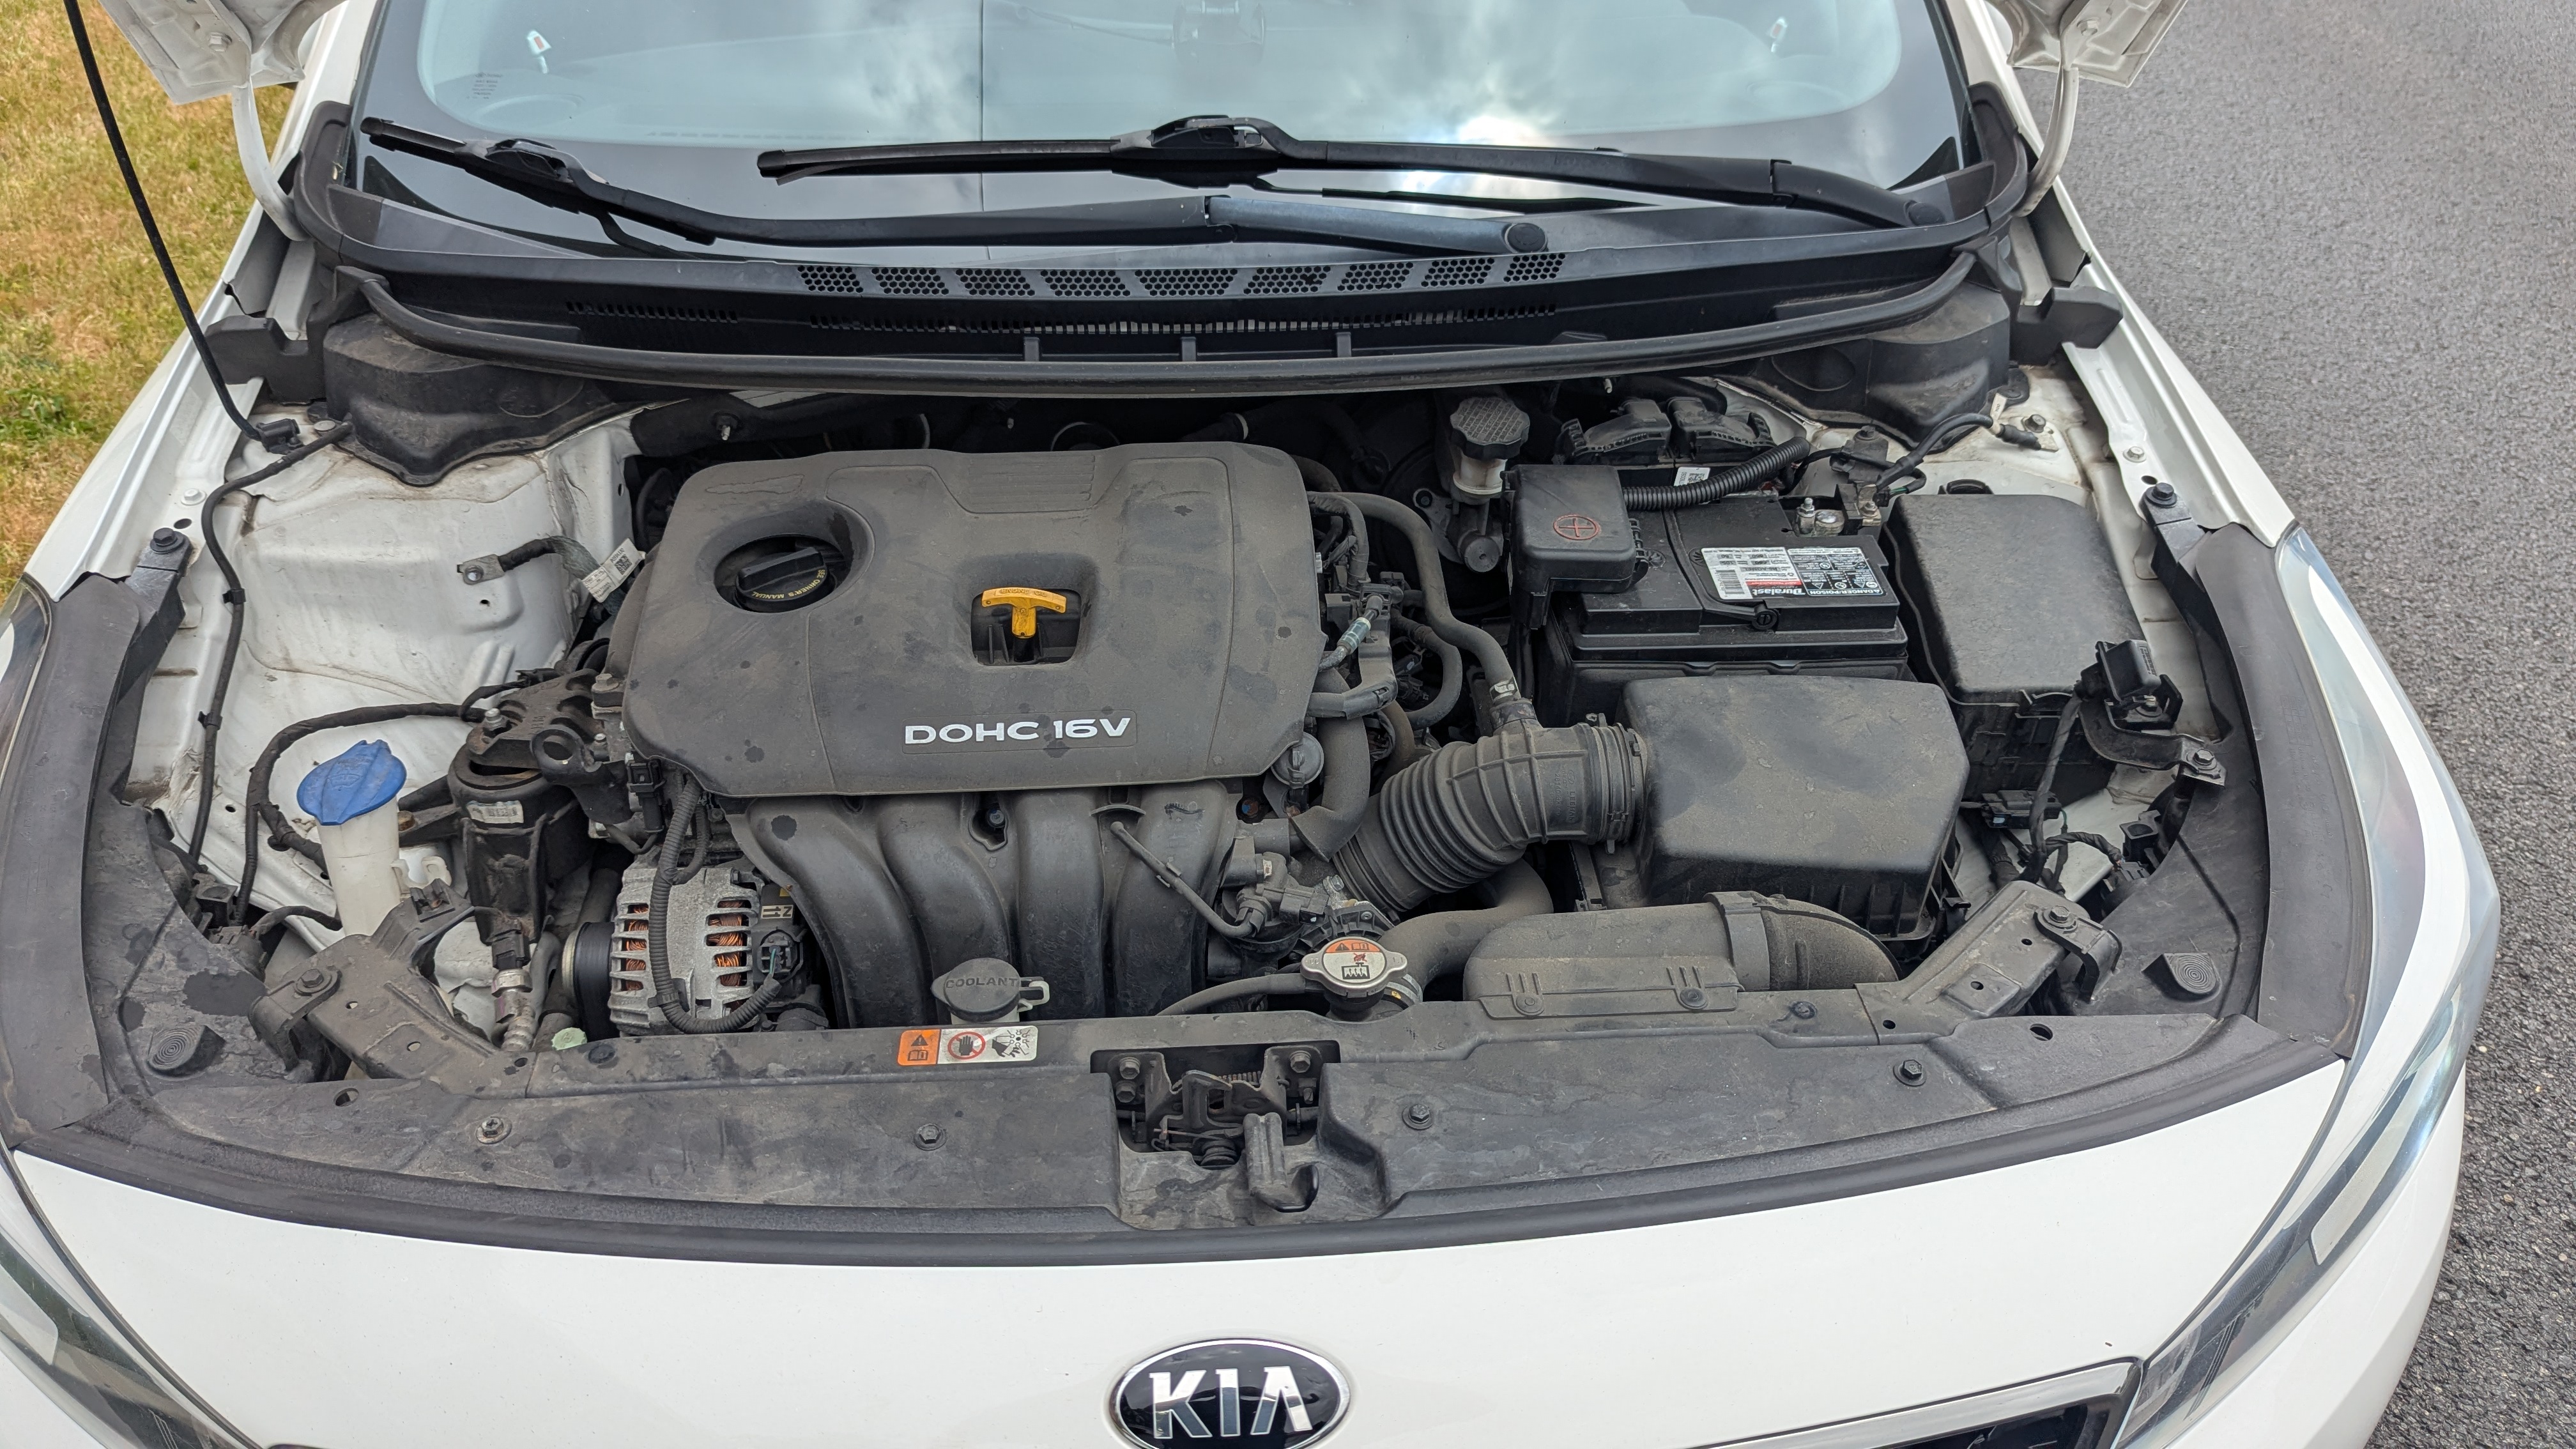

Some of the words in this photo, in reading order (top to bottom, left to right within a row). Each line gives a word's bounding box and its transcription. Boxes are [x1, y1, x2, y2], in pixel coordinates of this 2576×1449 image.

[816, 569, 825, 578] SEE
[788, 579, 820, 597] OWNER'S
[1752, 588, 1805, 596] Duralast
[751, 591, 785, 599] MANUAL
[905, 721, 1039, 746] DOHC
[1054, 717, 1131, 740] 16V
[946, 977, 1018, 988] COOLANT
[1149, 1367, 1314, 1439] KIA
